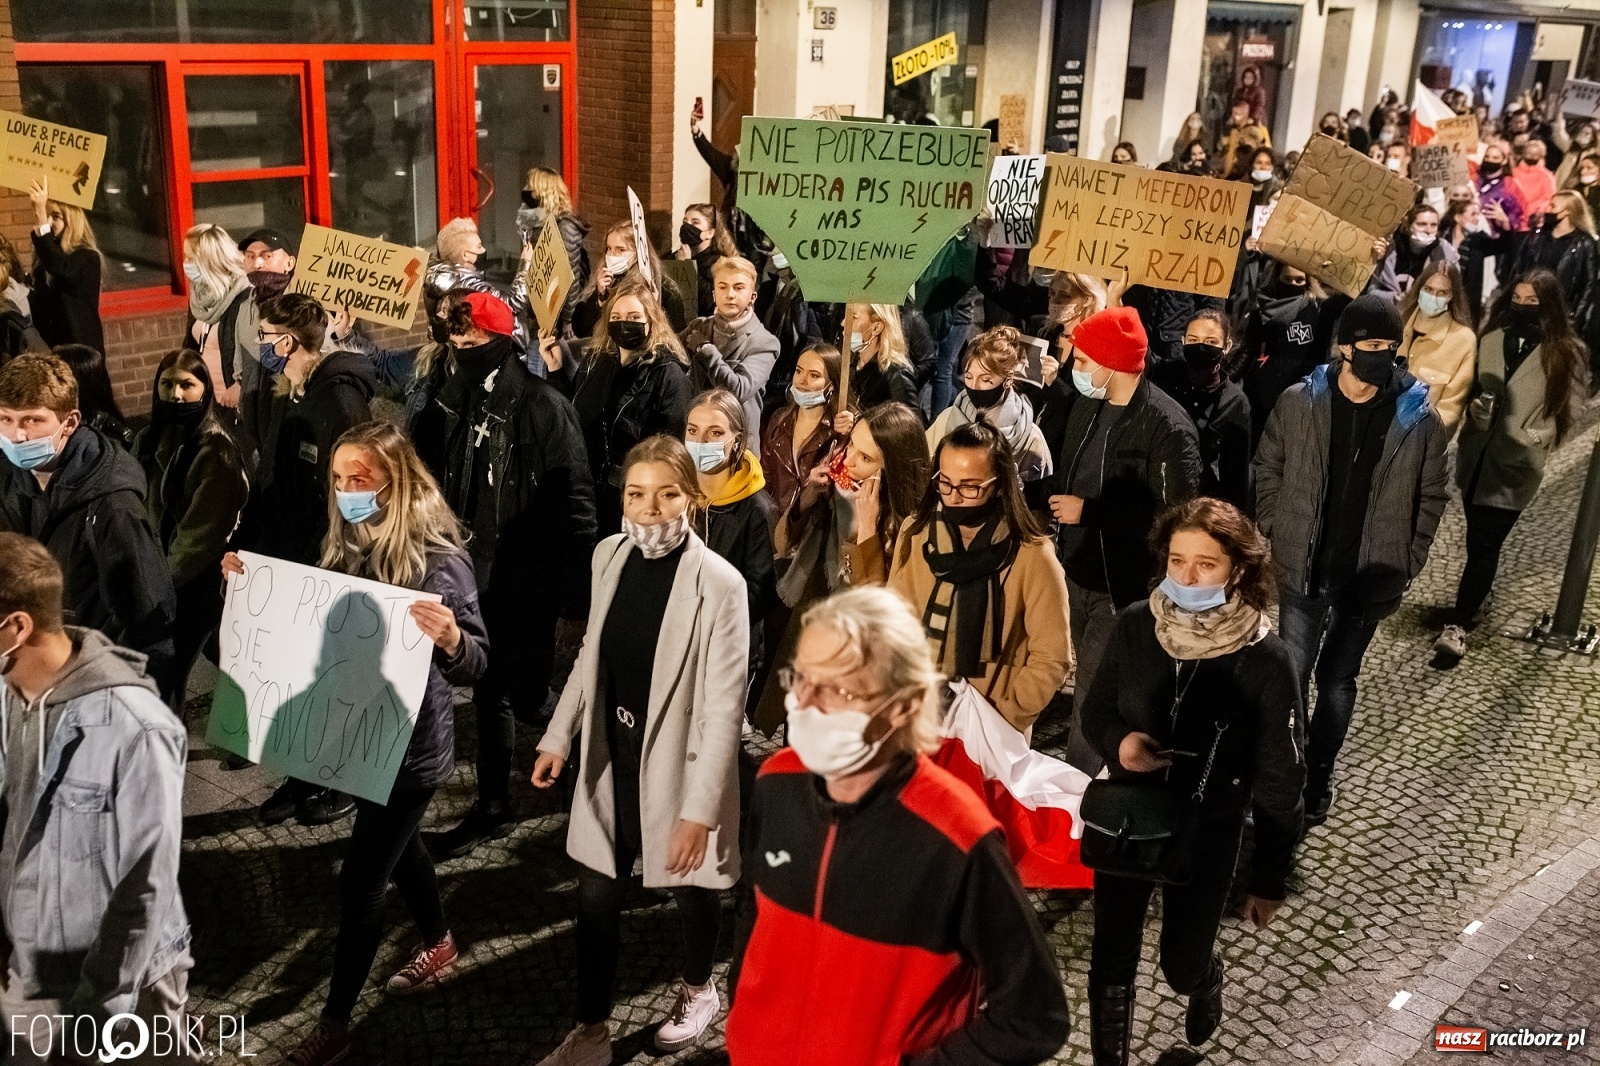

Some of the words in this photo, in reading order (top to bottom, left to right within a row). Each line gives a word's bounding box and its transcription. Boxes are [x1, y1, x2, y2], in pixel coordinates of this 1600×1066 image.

[820, 11, 835, 24] 36
[895, 50, 928, 80] ZŁOTO
[6, 119, 37, 138] LOVE
[39, 126, 48, 141] &
[52, 128, 90, 151] PEACE
[32, 141, 56, 157] ALE
[749, 124, 799, 164] NIE
[816, 126, 987, 168] POTRZEBUJE
[1007, 157, 1039, 179] NIE
[1322, 146, 1400, 201] MOJE
[739, 170, 845, 202] TINDERA
[856, 176, 891, 204] PIS
[900, 180, 974, 210] RUCHA
[1054, 164, 1126, 196] NAWET
[1136, 176, 1238, 217] MEFEDRON
[1305, 172, 1398, 228] CIAŁO
[817, 208, 862, 230] NAS
[1052, 199, 1080, 222] MA
[1096, 204, 1172, 237] LEPSZY
[1179, 218, 1241, 249] SKŁAD
[308, 254, 323, 272] Z
[323, 233, 397, 265] WALCZCIE
[796, 238, 918, 261] CODZIENNIE
[1076, 238, 1130, 270] NIŻ
[1145, 248, 1225, 291] RZĄD
[535, 278, 544, 299] TO
[542, 252, 556, 286] HELL
[295, 279, 320, 298] NIE
[321, 284, 332, 302] Z
[334, 287, 411, 320] KOBIETAMI
[230, 562, 273, 617] PO
[293, 576, 427, 651] PROSTO
[230, 620, 271, 668] SIĘ
